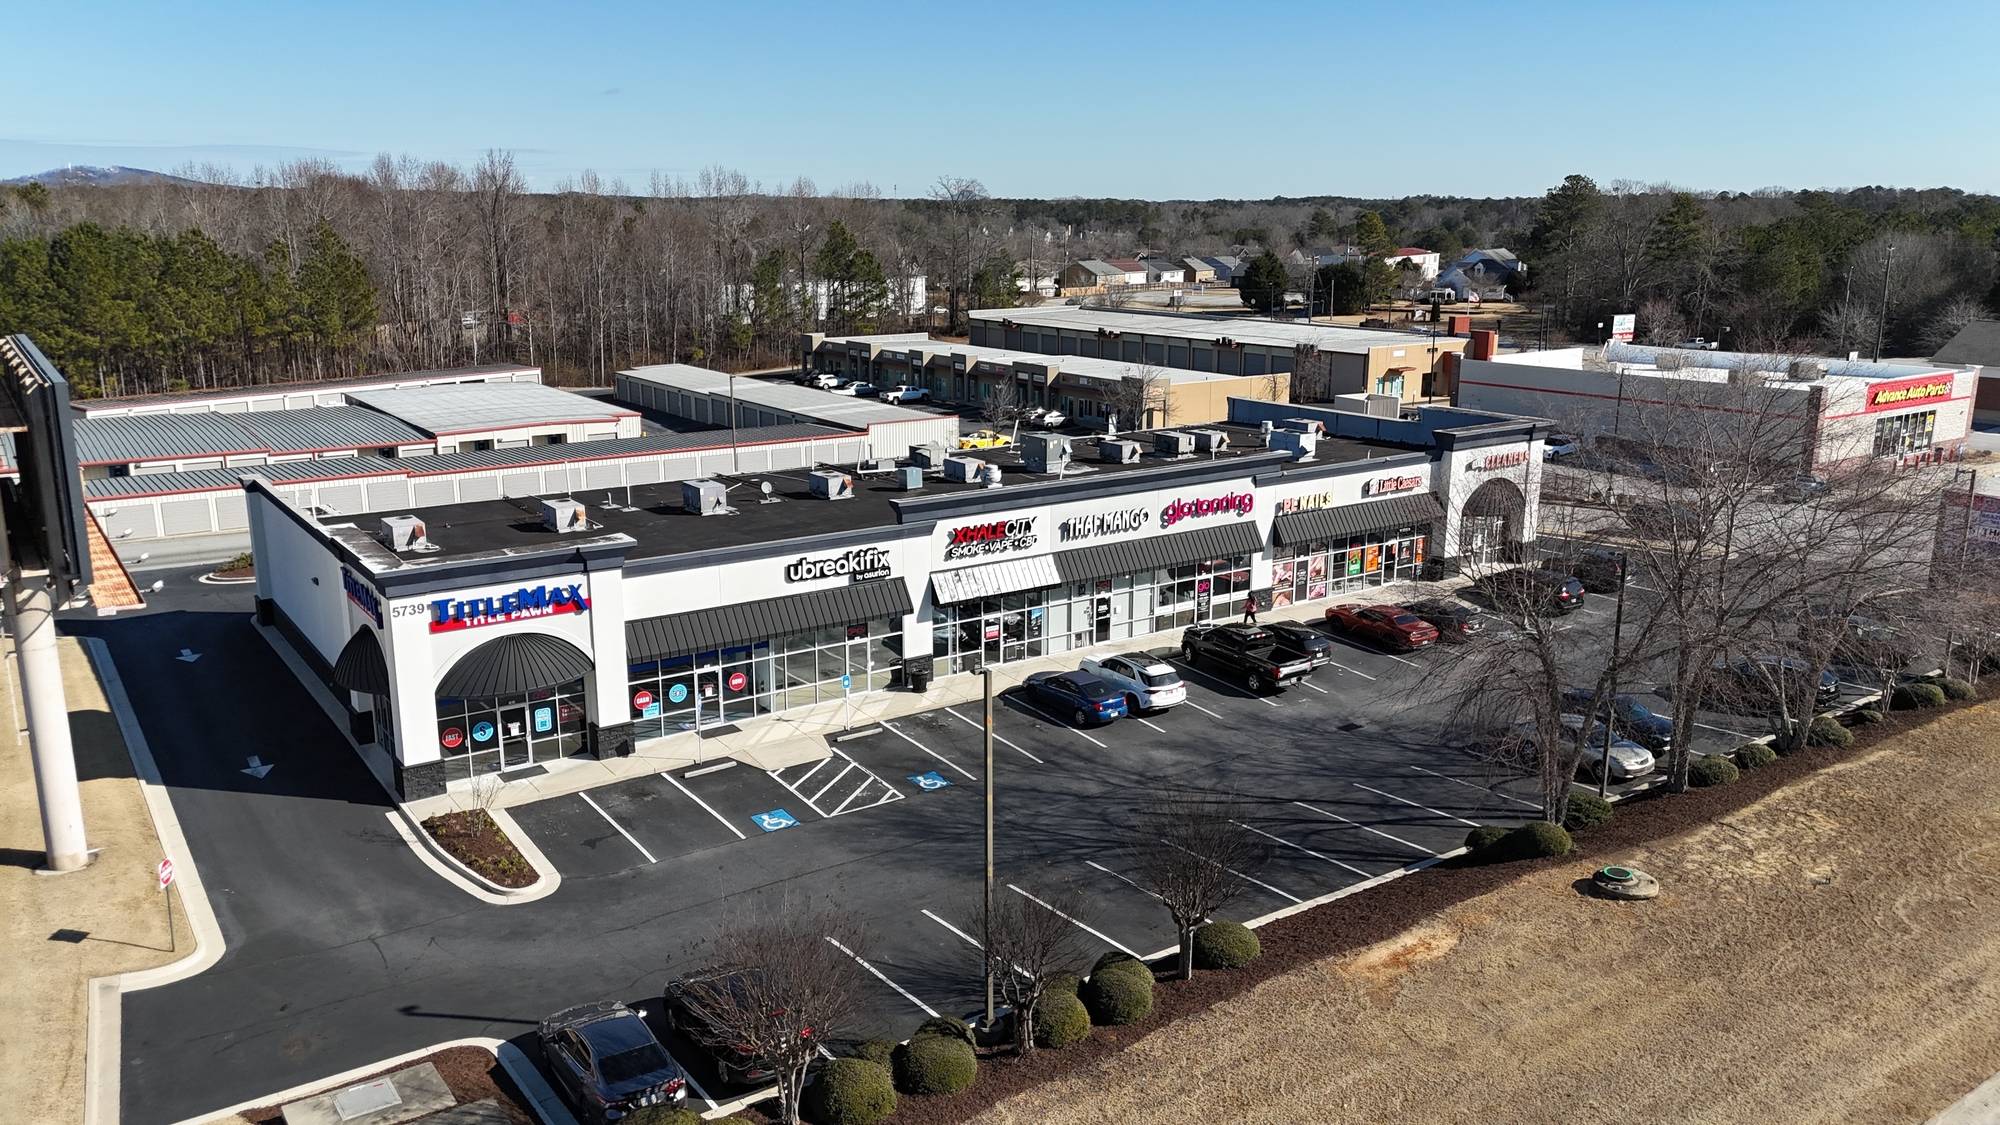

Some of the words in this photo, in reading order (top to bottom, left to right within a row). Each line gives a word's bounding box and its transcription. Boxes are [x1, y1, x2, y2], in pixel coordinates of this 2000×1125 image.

[1875, 389, 1907, 403] Advance
[1907, 385, 1926, 399] Auto
[1925, 383, 1946, 397] Parts
[1380, 478, 1397, 492] Little
[1398, 476, 1422, 489] Caesars
[1300, 491, 1331, 510] NAILS
[789, 548, 889, 580] ubreakifix
[863, 568, 890, 579] asurion
[1198, 581, 1210, 593] glo
[392, 603, 425, 618] 5739
[463, 612, 505, 627] TITLE
[511, 604, 553, 621] PAWN
